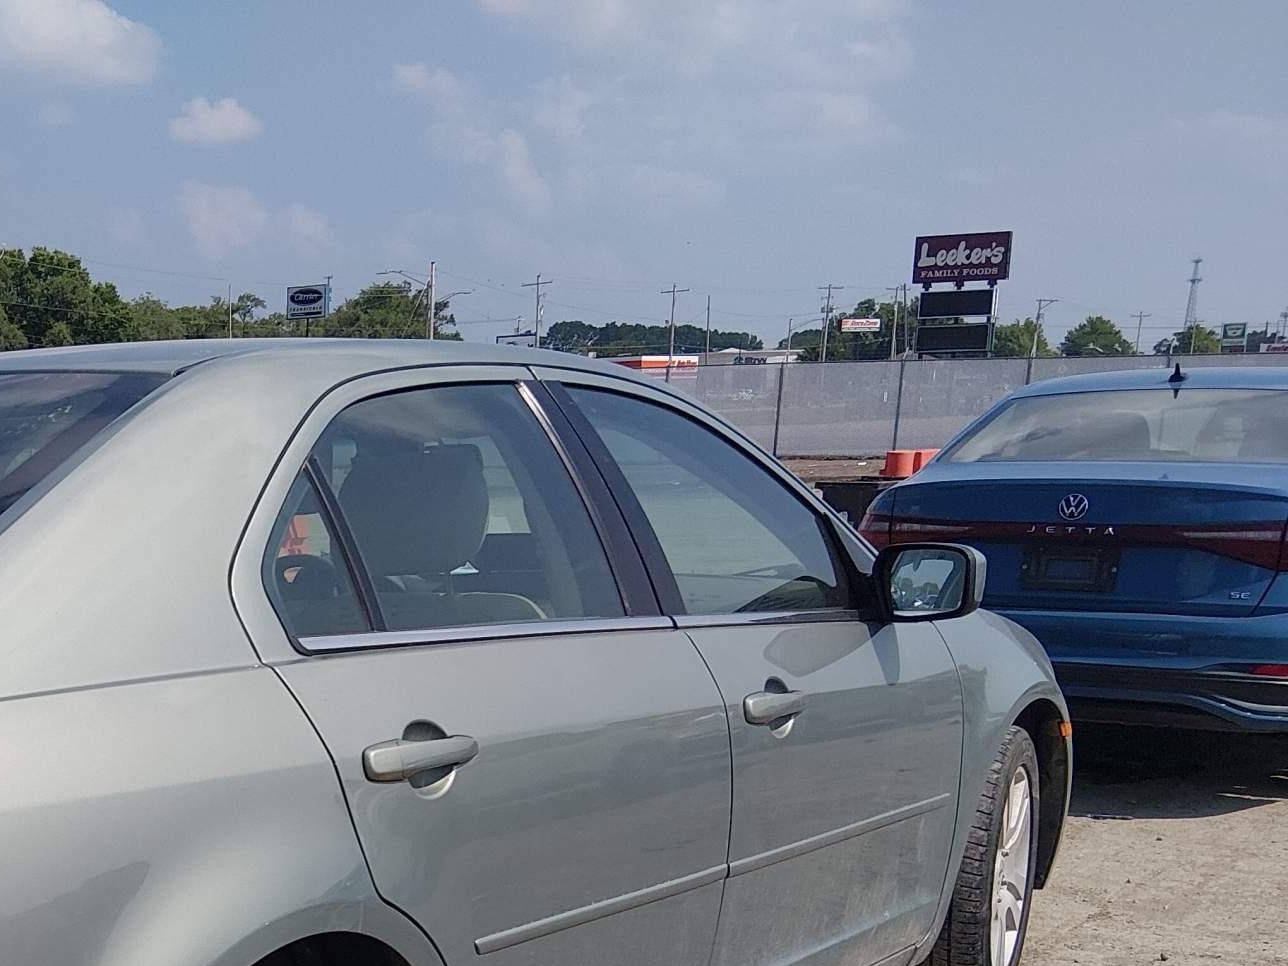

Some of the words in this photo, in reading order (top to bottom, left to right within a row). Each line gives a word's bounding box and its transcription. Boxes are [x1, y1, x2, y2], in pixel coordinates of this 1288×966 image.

[917, 240, 1005, 268] Leeker's
[920, 269, 960, 278] FAMILY
[962, 267, 999, 276] FOODS
[1026, 524, 1115, 536] JETTA
[1229, 591, 1251, 600] SE
